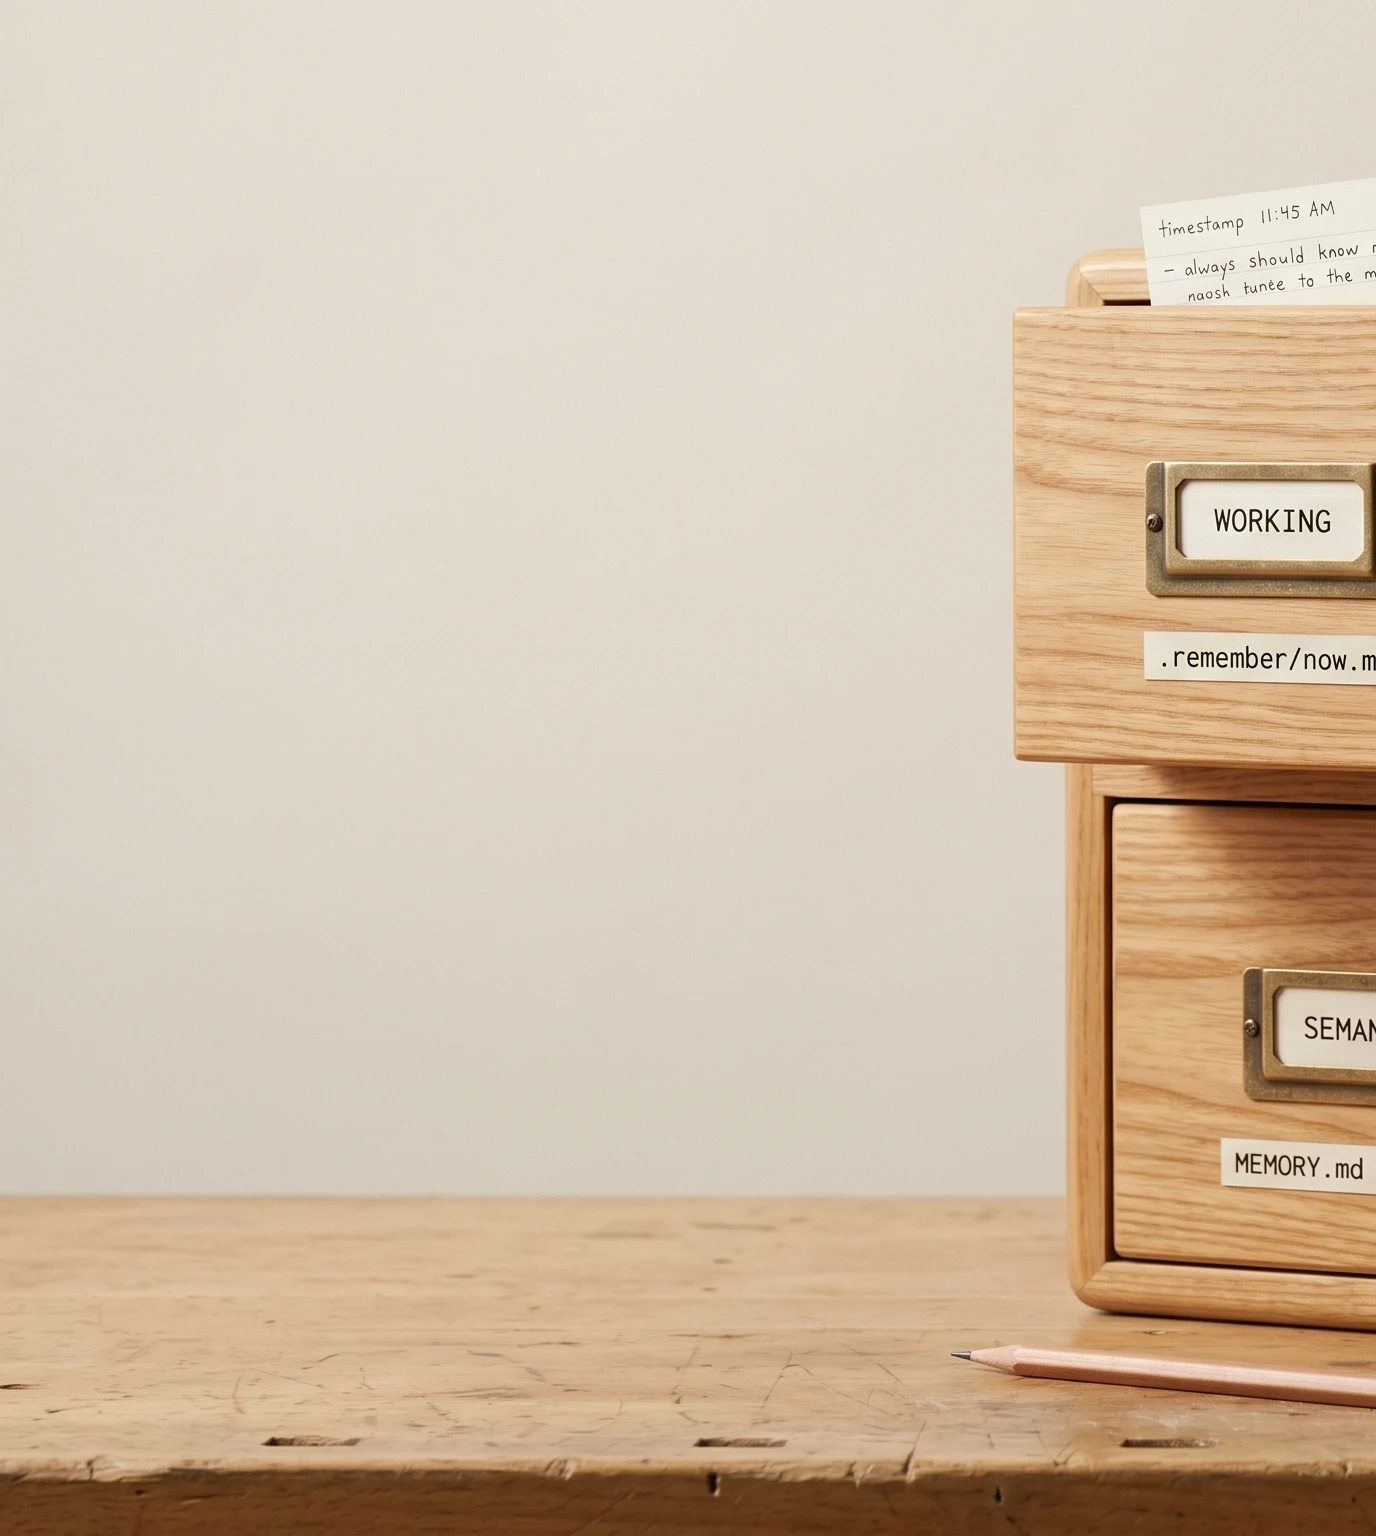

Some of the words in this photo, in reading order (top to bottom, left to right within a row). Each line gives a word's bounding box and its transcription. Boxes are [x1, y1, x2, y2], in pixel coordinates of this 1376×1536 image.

[1158, 215, 1244, 238] timestamp
[1261, 204, 1300, 224] 11:45
[1309, 200, 1336, 218] AM
[1184, 258, 1236, 281] always
[1249, 245, 1304, 269] should
[1318, 243, 1359, 260] know
[1297, 273, 1314, 288] to
[1326, 268, 1353, 284] the
[1214, 508, 1331, 534] WORKING
[1235, 1152, 1363, 1180] MEMORY.md
